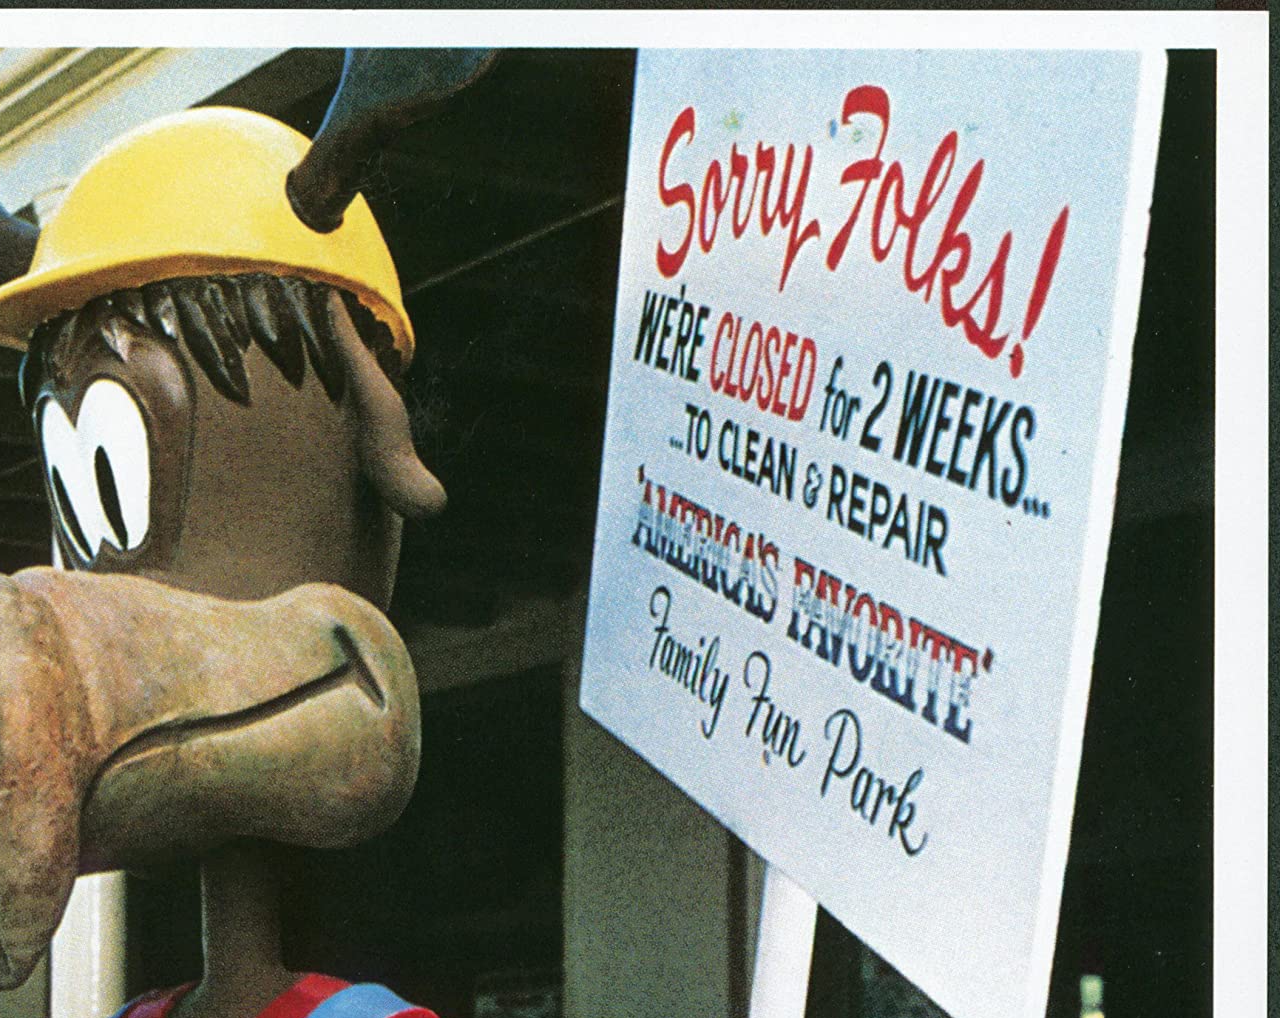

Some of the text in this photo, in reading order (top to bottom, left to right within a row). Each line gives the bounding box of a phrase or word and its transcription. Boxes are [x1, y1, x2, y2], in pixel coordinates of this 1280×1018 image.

[825, 84, 1069, 379] Folks!
[633, 284, 1052, 520] WE'RE CLOSED for 2 WEEKS...
[717, 418, 797, 502] CLEAN
[803, 462, 823, 510] &
[826, 463, 949, 578] REPAIR
[649, 585, 929, 857] Family Fun Park
